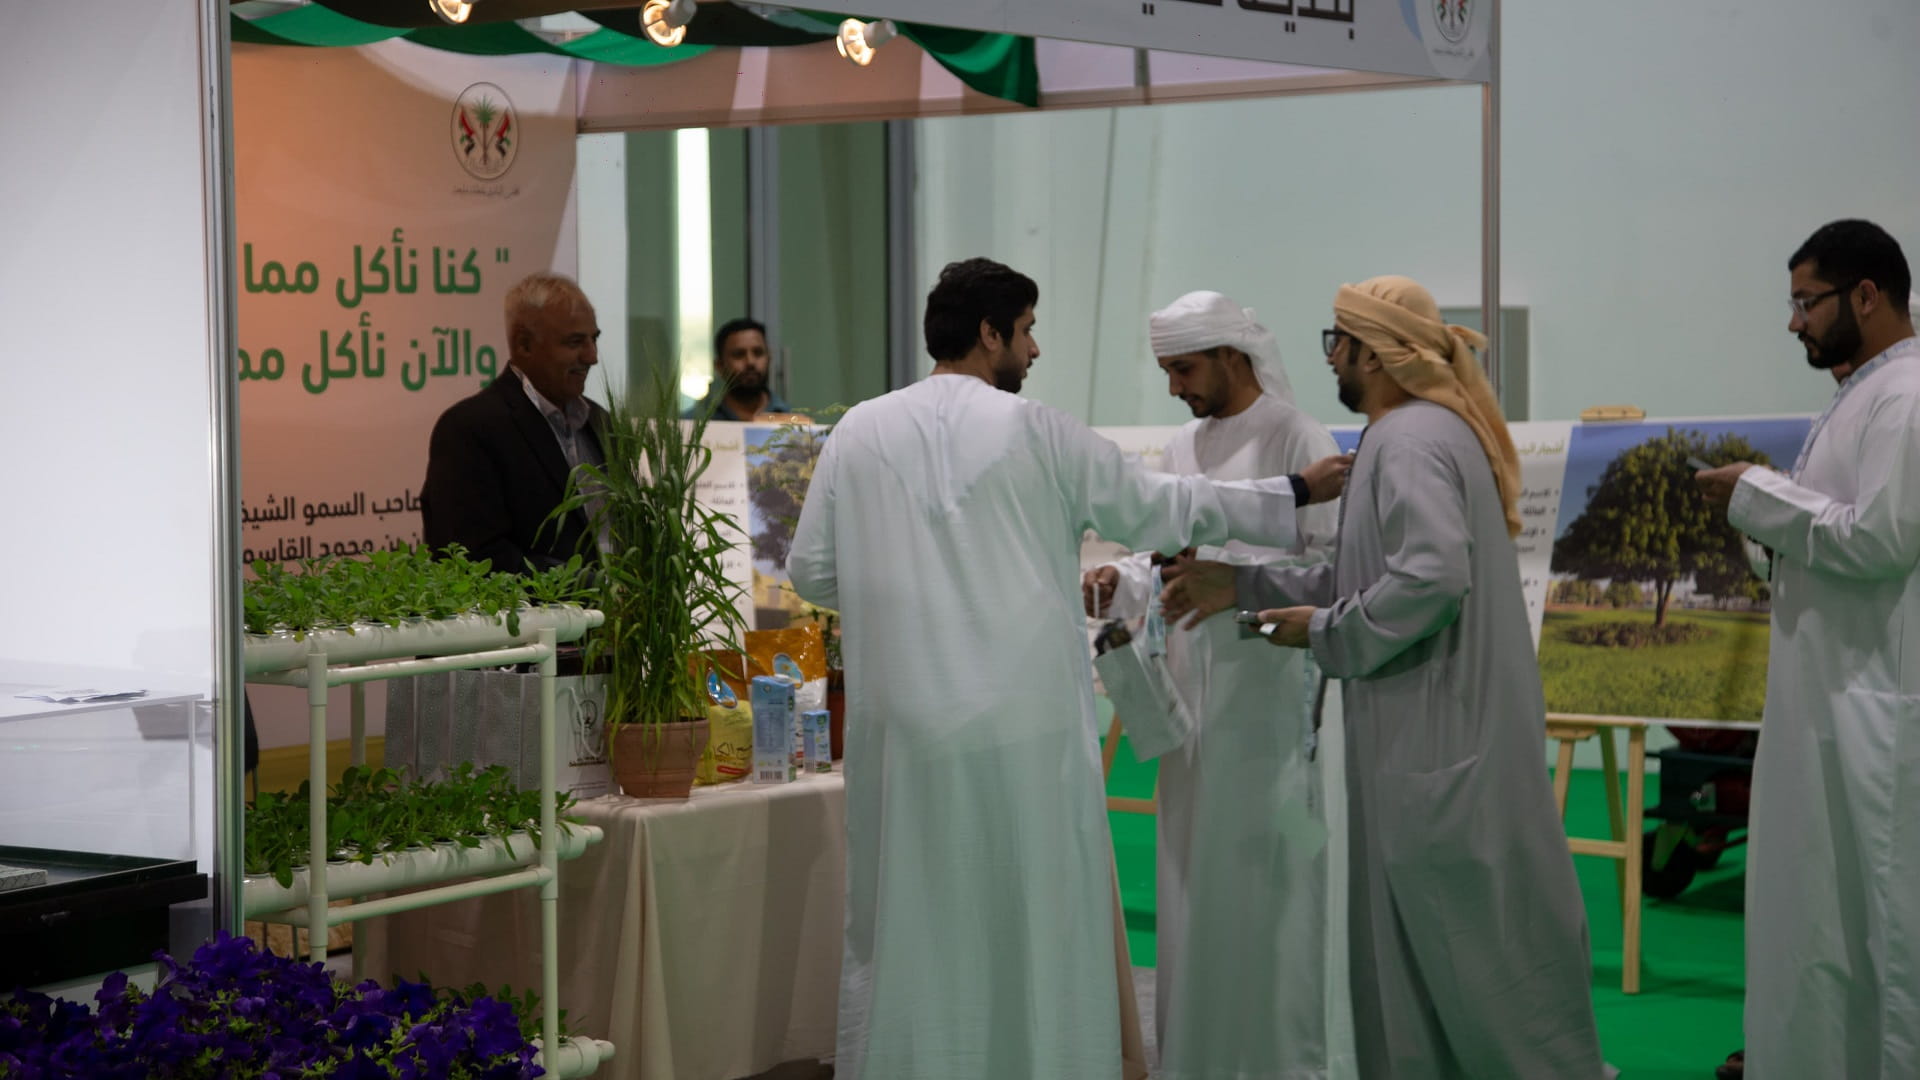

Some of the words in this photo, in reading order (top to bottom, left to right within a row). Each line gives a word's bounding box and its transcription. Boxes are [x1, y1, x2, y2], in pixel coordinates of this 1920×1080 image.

[243, 242, 319, 294] مما
[336, 227, 418, 309] نأكل
[432, 246, 481, 294] كنا
[238, 347, 285, 381] مم
[302, 312, 385, 394] نأكل
[401, 326, 497, 391] والآن
[302, 491, 364, 526] السمو
[242, 536, 312, 565] القاسم
[319, 539, 374, 560] محمد
